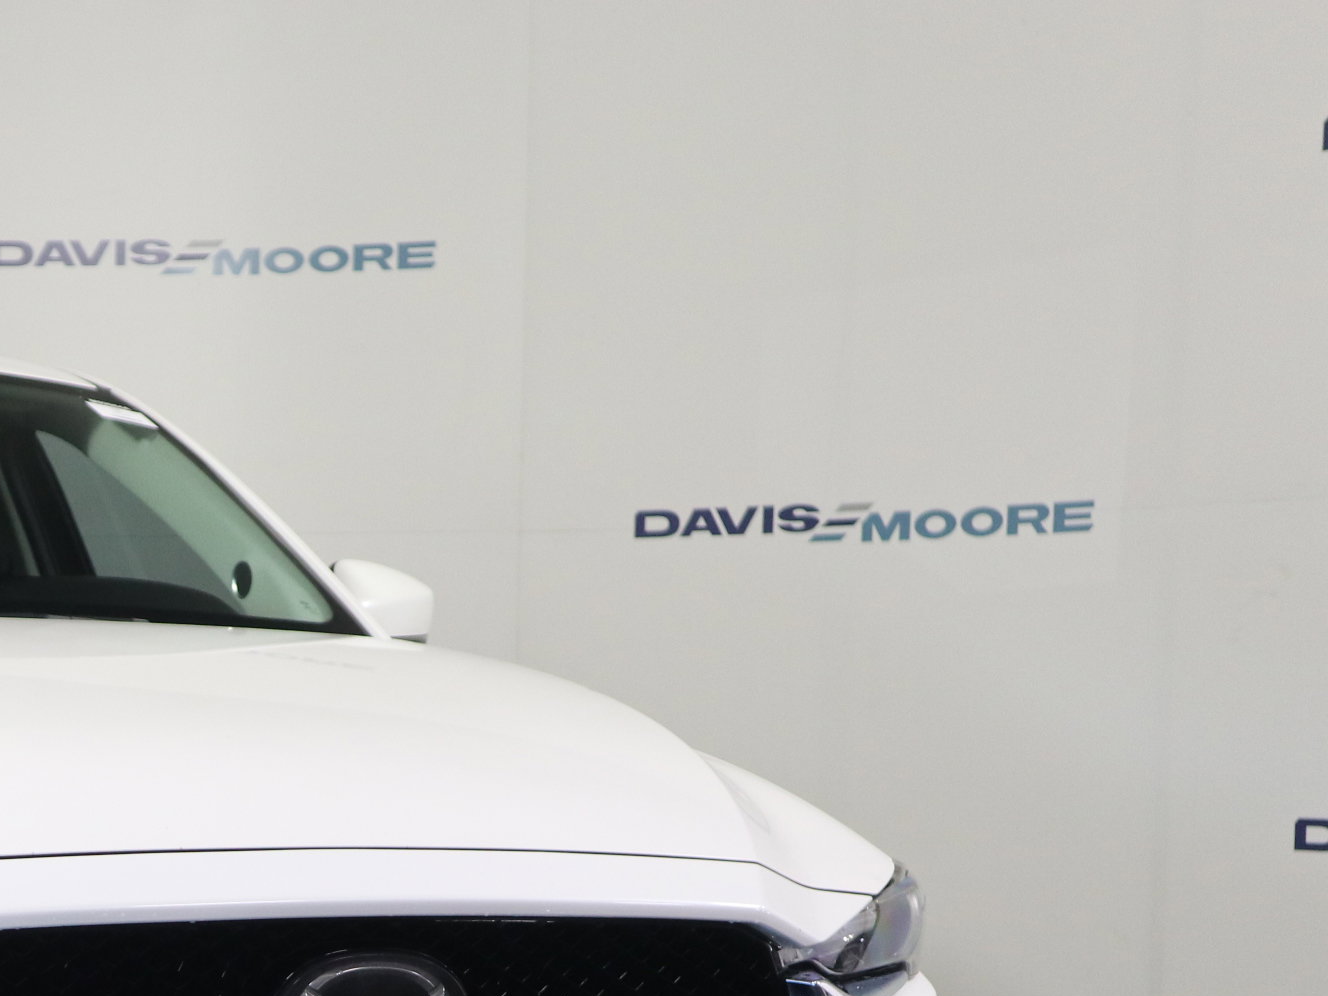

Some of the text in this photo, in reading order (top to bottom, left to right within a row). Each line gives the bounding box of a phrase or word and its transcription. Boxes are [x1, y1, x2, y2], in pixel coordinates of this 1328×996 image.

[211, 240, 438, 276] MOORE
[634, 500, 1096, 543] DAVIS MOORE
